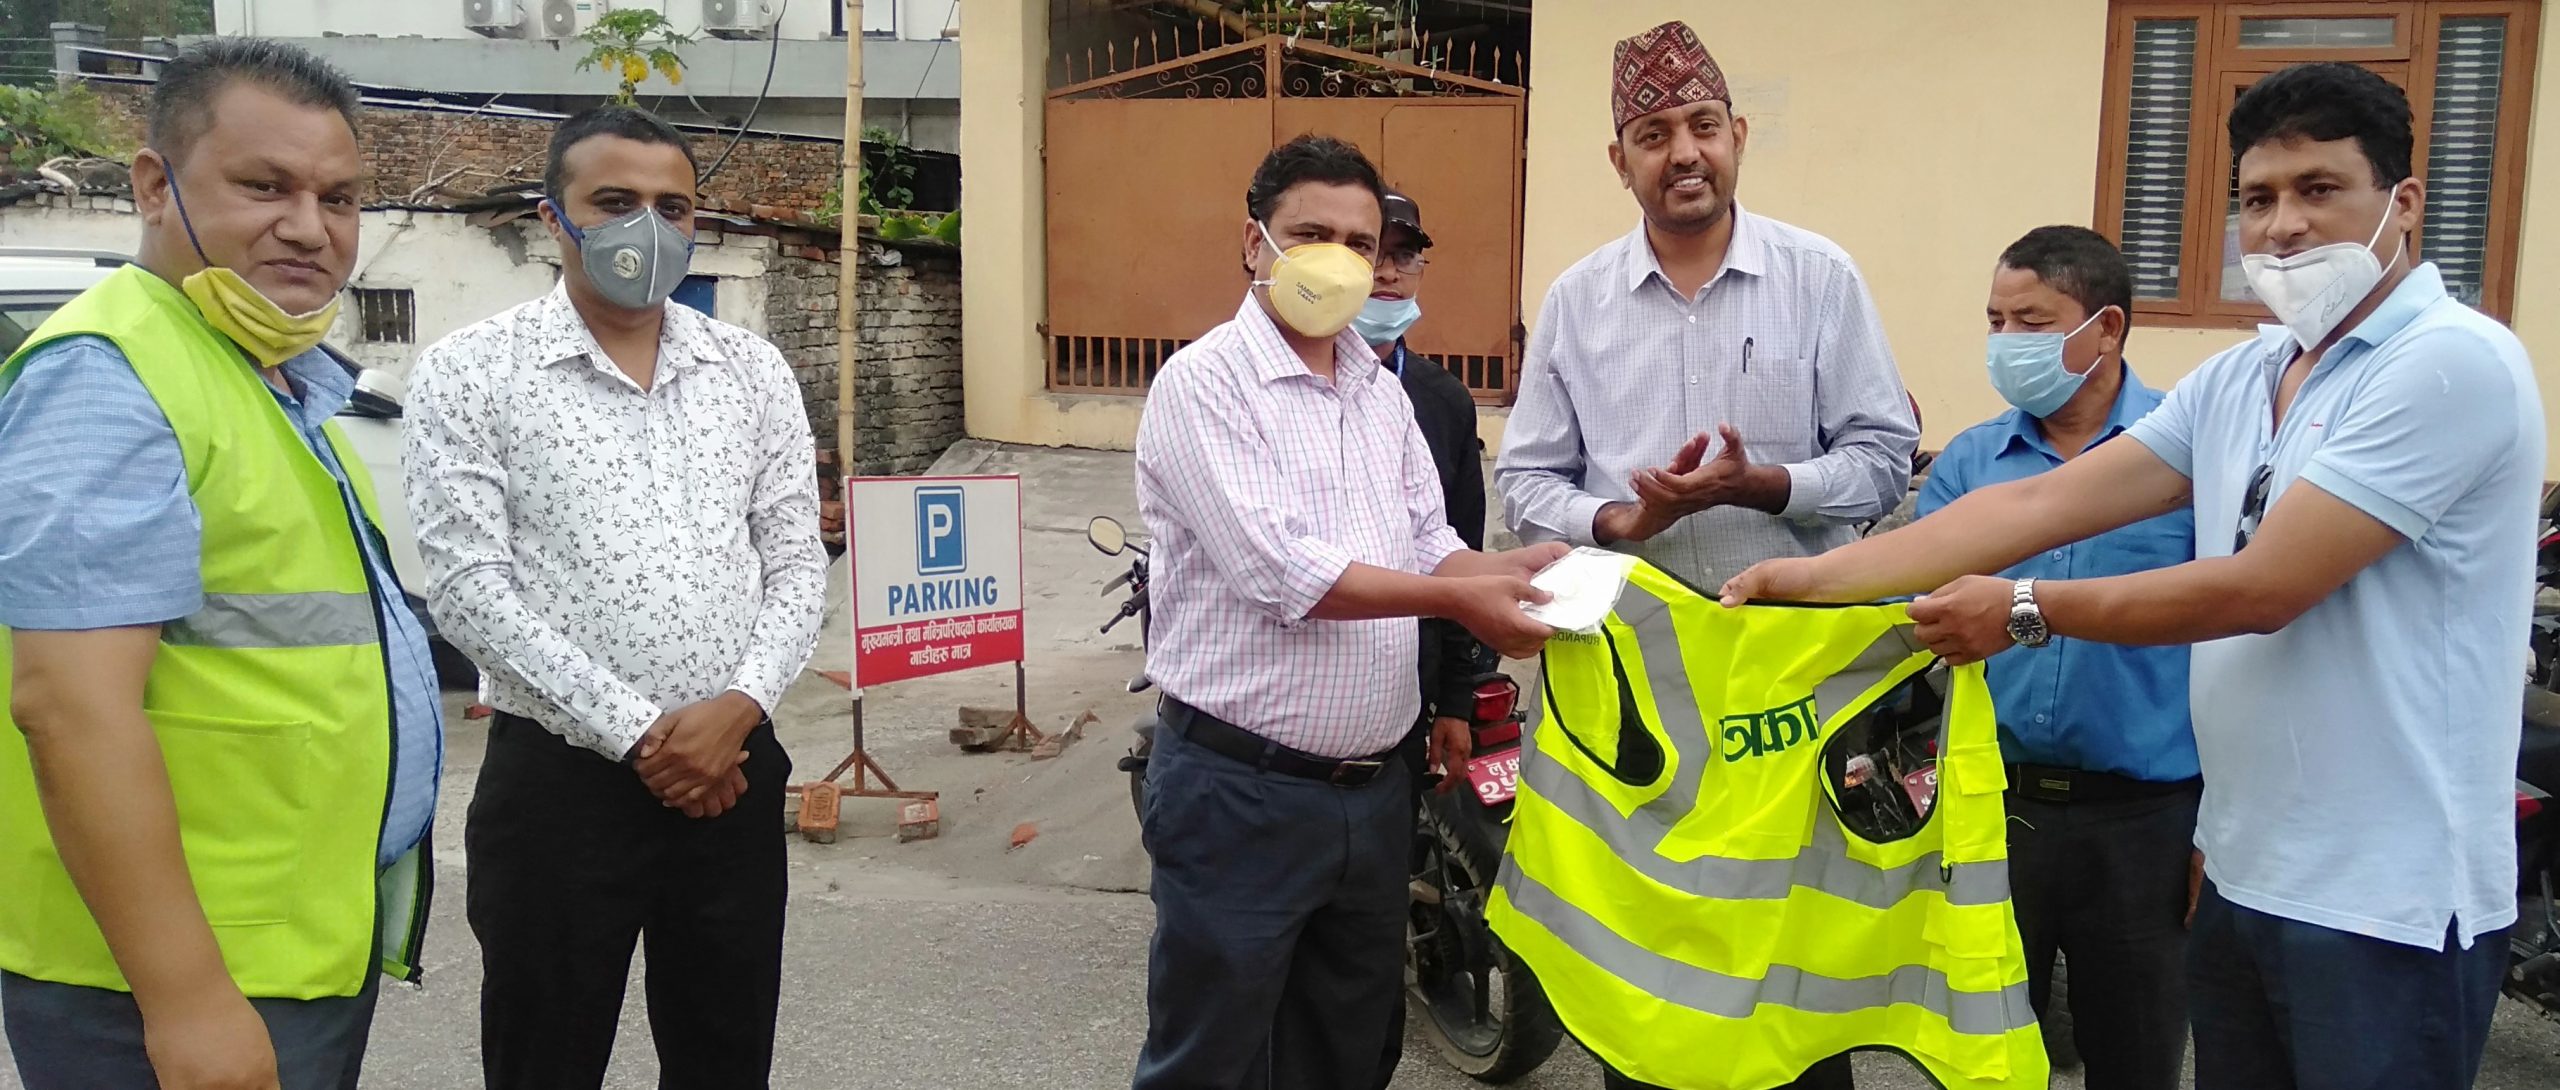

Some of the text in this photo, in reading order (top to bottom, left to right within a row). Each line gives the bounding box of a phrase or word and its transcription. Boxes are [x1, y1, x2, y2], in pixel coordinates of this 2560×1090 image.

[928, 504, 953, 558] P
[888, 576, 998, 616] PARKING
[861, 625, 903, 654] मुख्यमन्त्री
[905, 627, 921, 644] तथा
[951, 643, 971, 660] मात्र
[1719, 693, 1818, 762] त्रका
